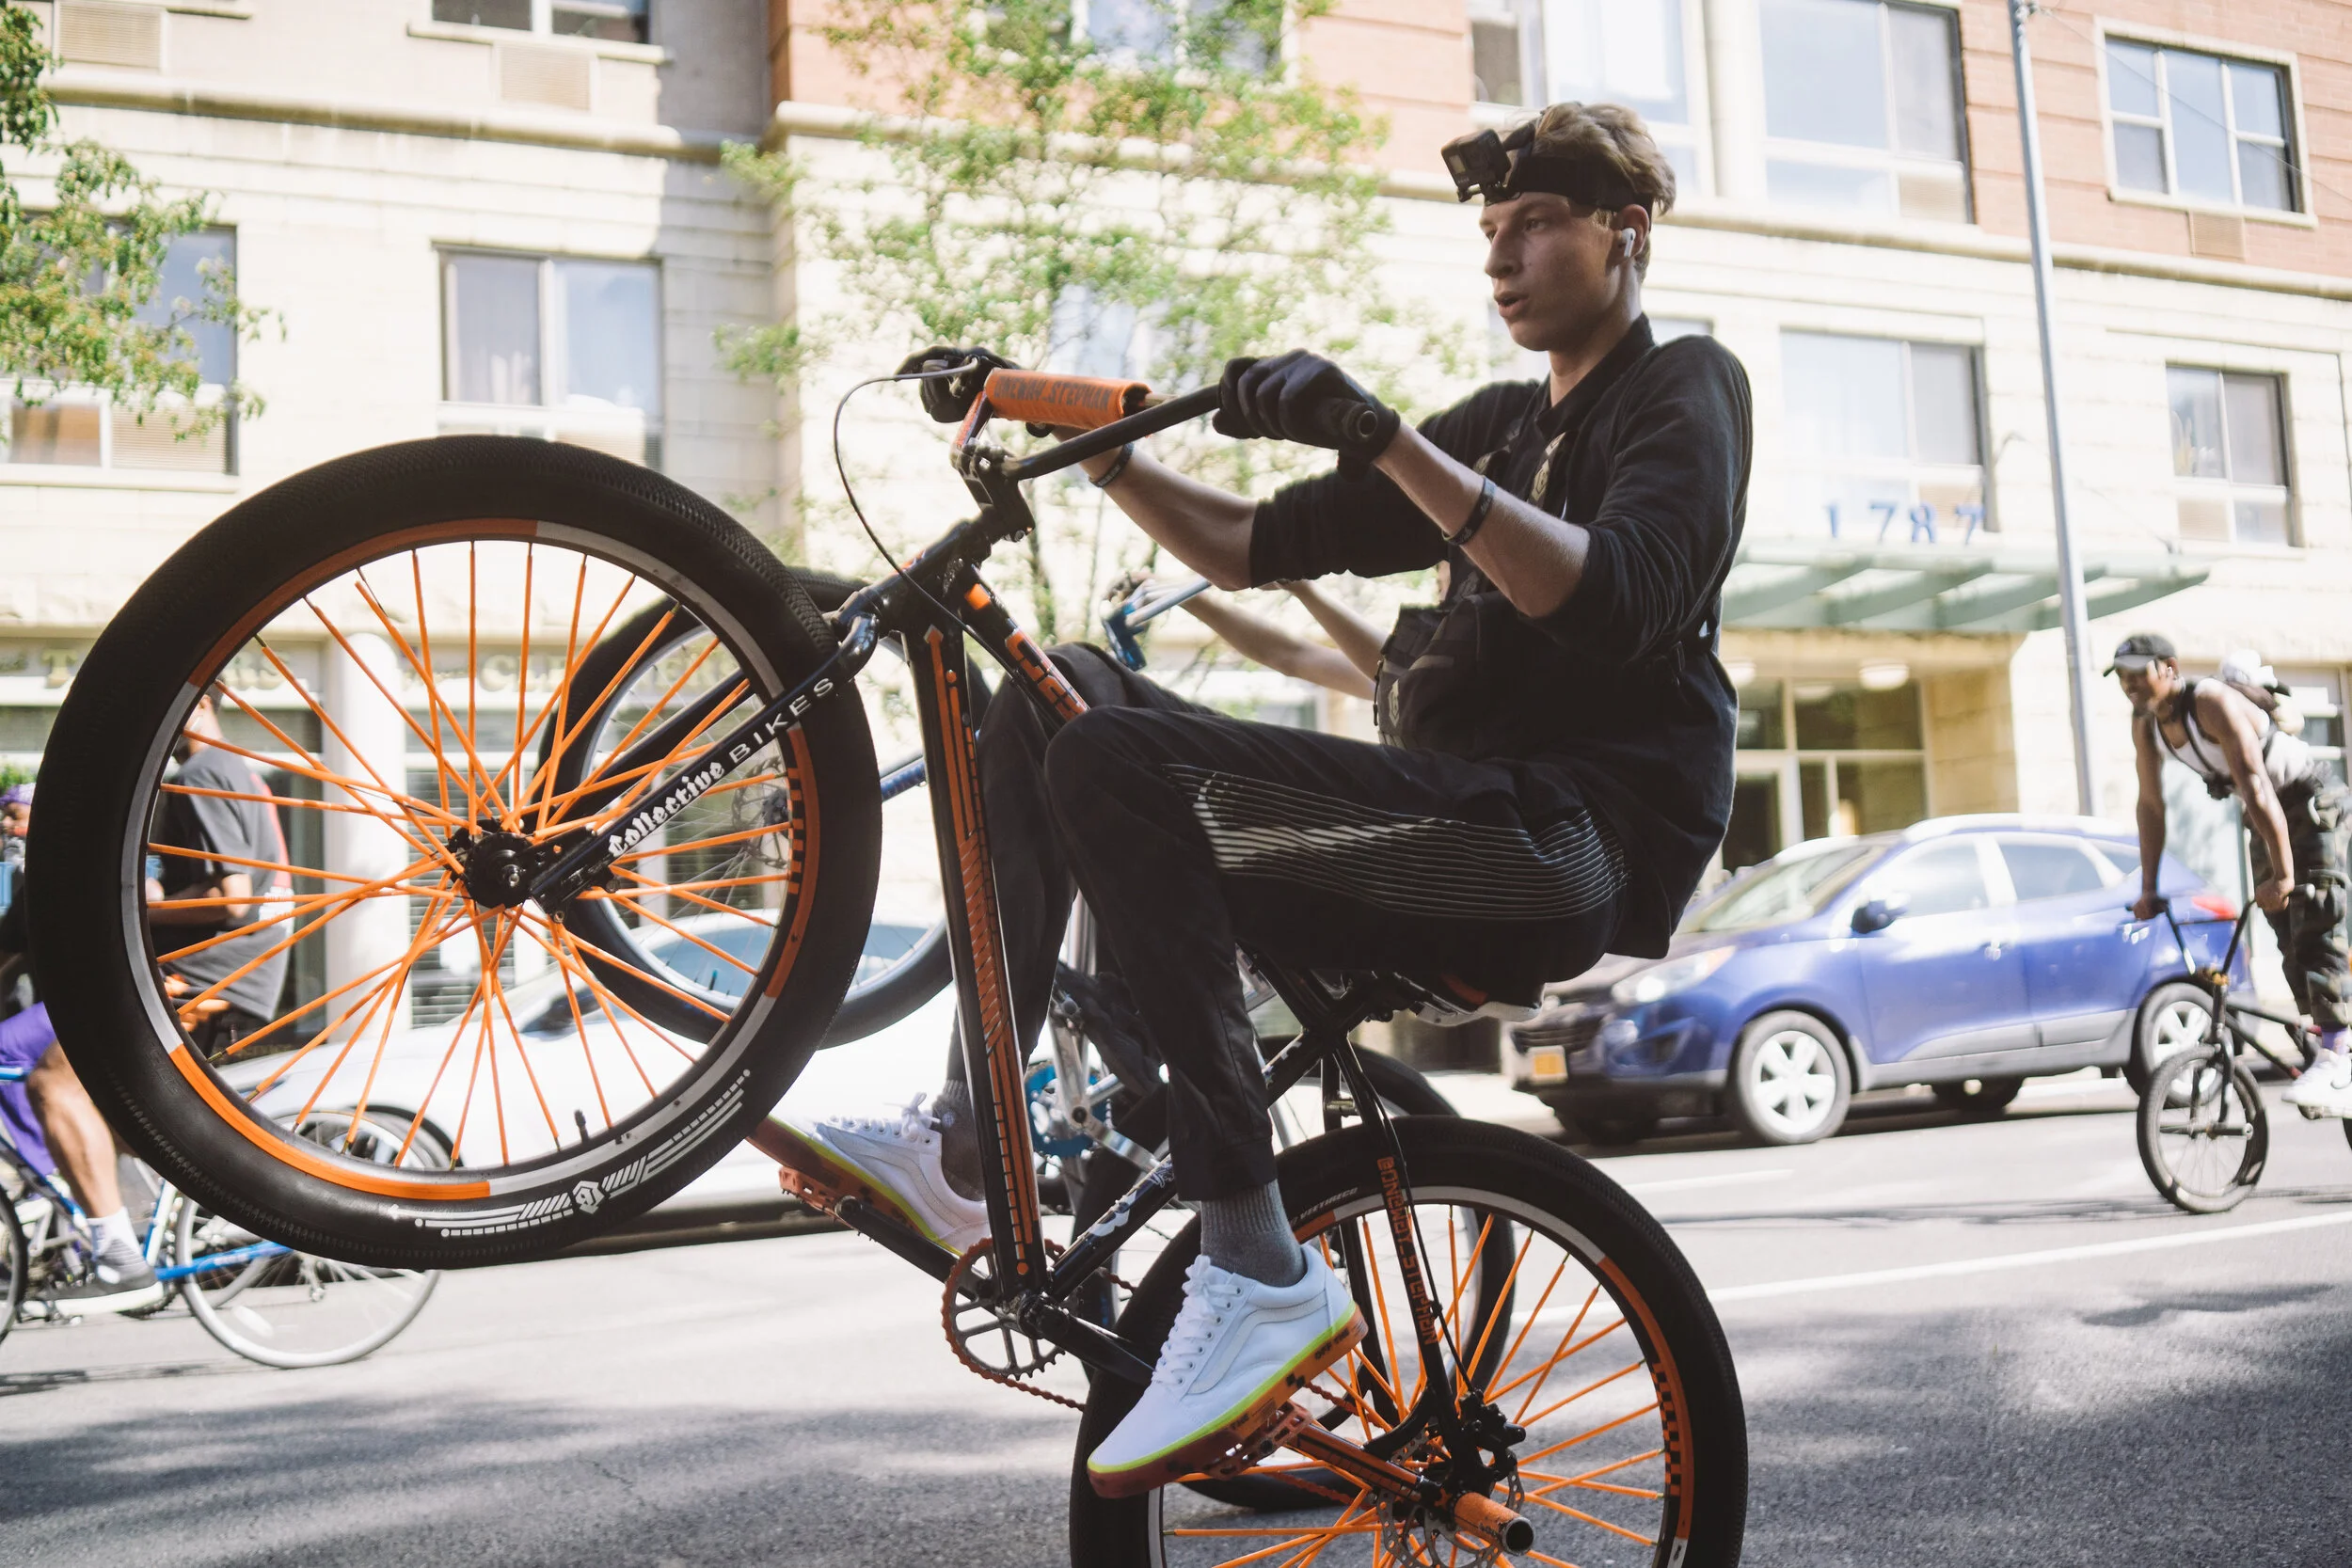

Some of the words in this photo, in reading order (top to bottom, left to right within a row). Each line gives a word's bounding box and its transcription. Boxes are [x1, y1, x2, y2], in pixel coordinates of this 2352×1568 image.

[1823, 499, 1986, 545] 1787
[609, 761, 725, 857] Collective
[729, 677, 834, 764] BIKES
